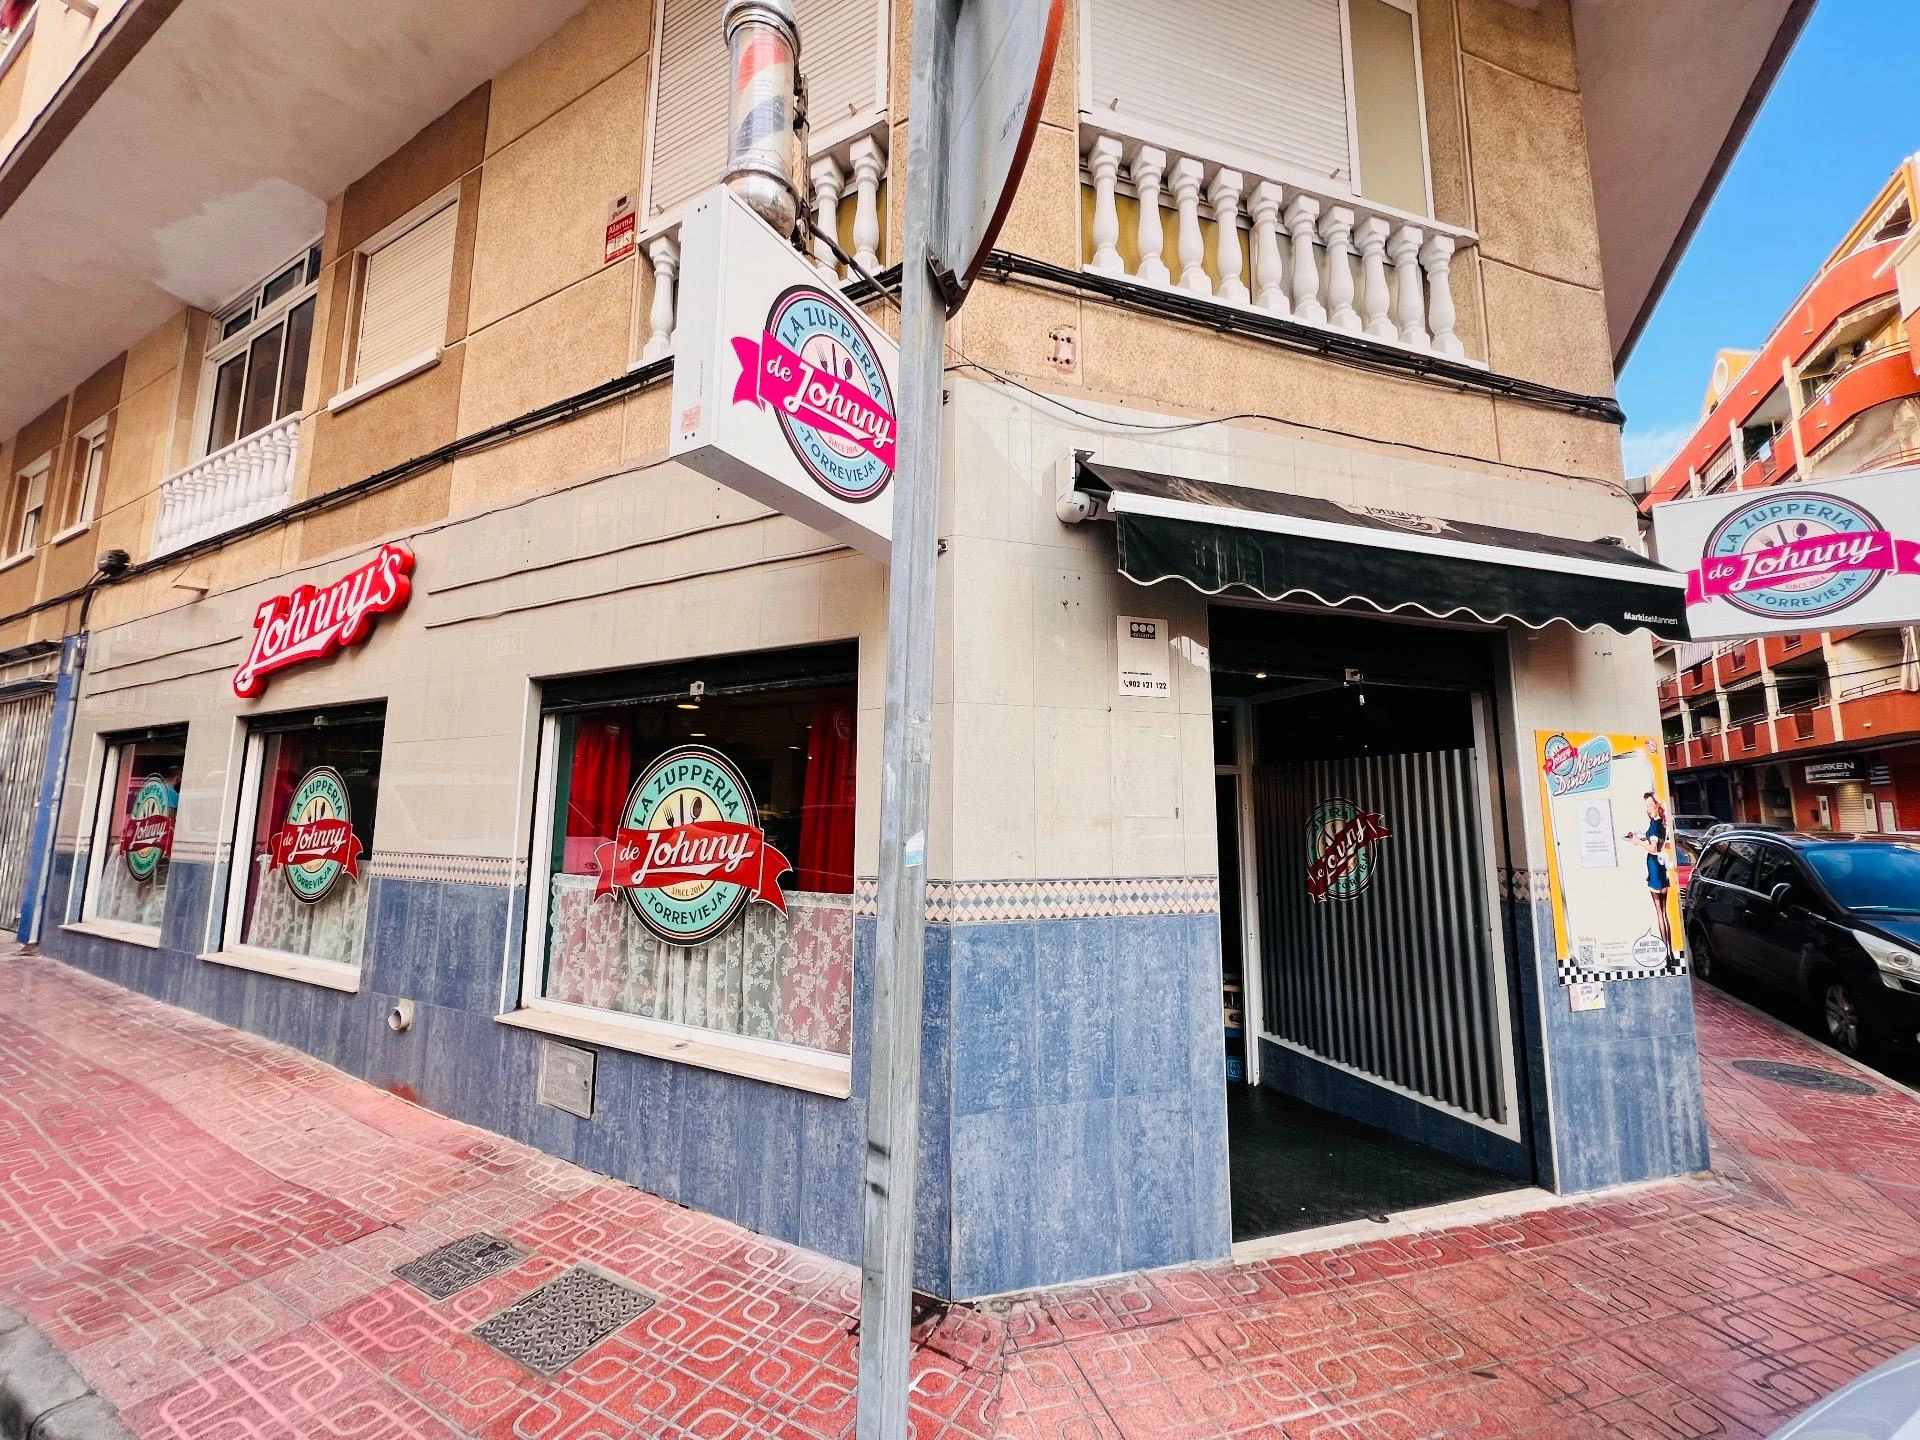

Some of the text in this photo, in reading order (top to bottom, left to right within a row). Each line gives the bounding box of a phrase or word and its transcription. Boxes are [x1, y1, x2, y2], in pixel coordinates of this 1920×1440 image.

[608, 216, 633, 234] Alarma
[786, 306, 883, 399] LA ZUPPERIA
[766, 354, 793, 382] de
[783, 362, 895, 450] Johnny
[1720, 503, 1855, 553] LA ZUPPERIA
[1708, 535, 1884, 591] de Johnny
[1129, 680, 1141, 688] 902
[1552, 772, 1593, 796] Diner
[1573, 750, 1610, 777] Menu
[292, 780, 343, 822] LA ZUPPERIA
[634, 765, 739, 827] LA ZUPPERIA
[283, 825, 347, 862] de Johnny
[620, 830, 754, 884] de Johnny
[671, 886, 689, 897] SINCE
